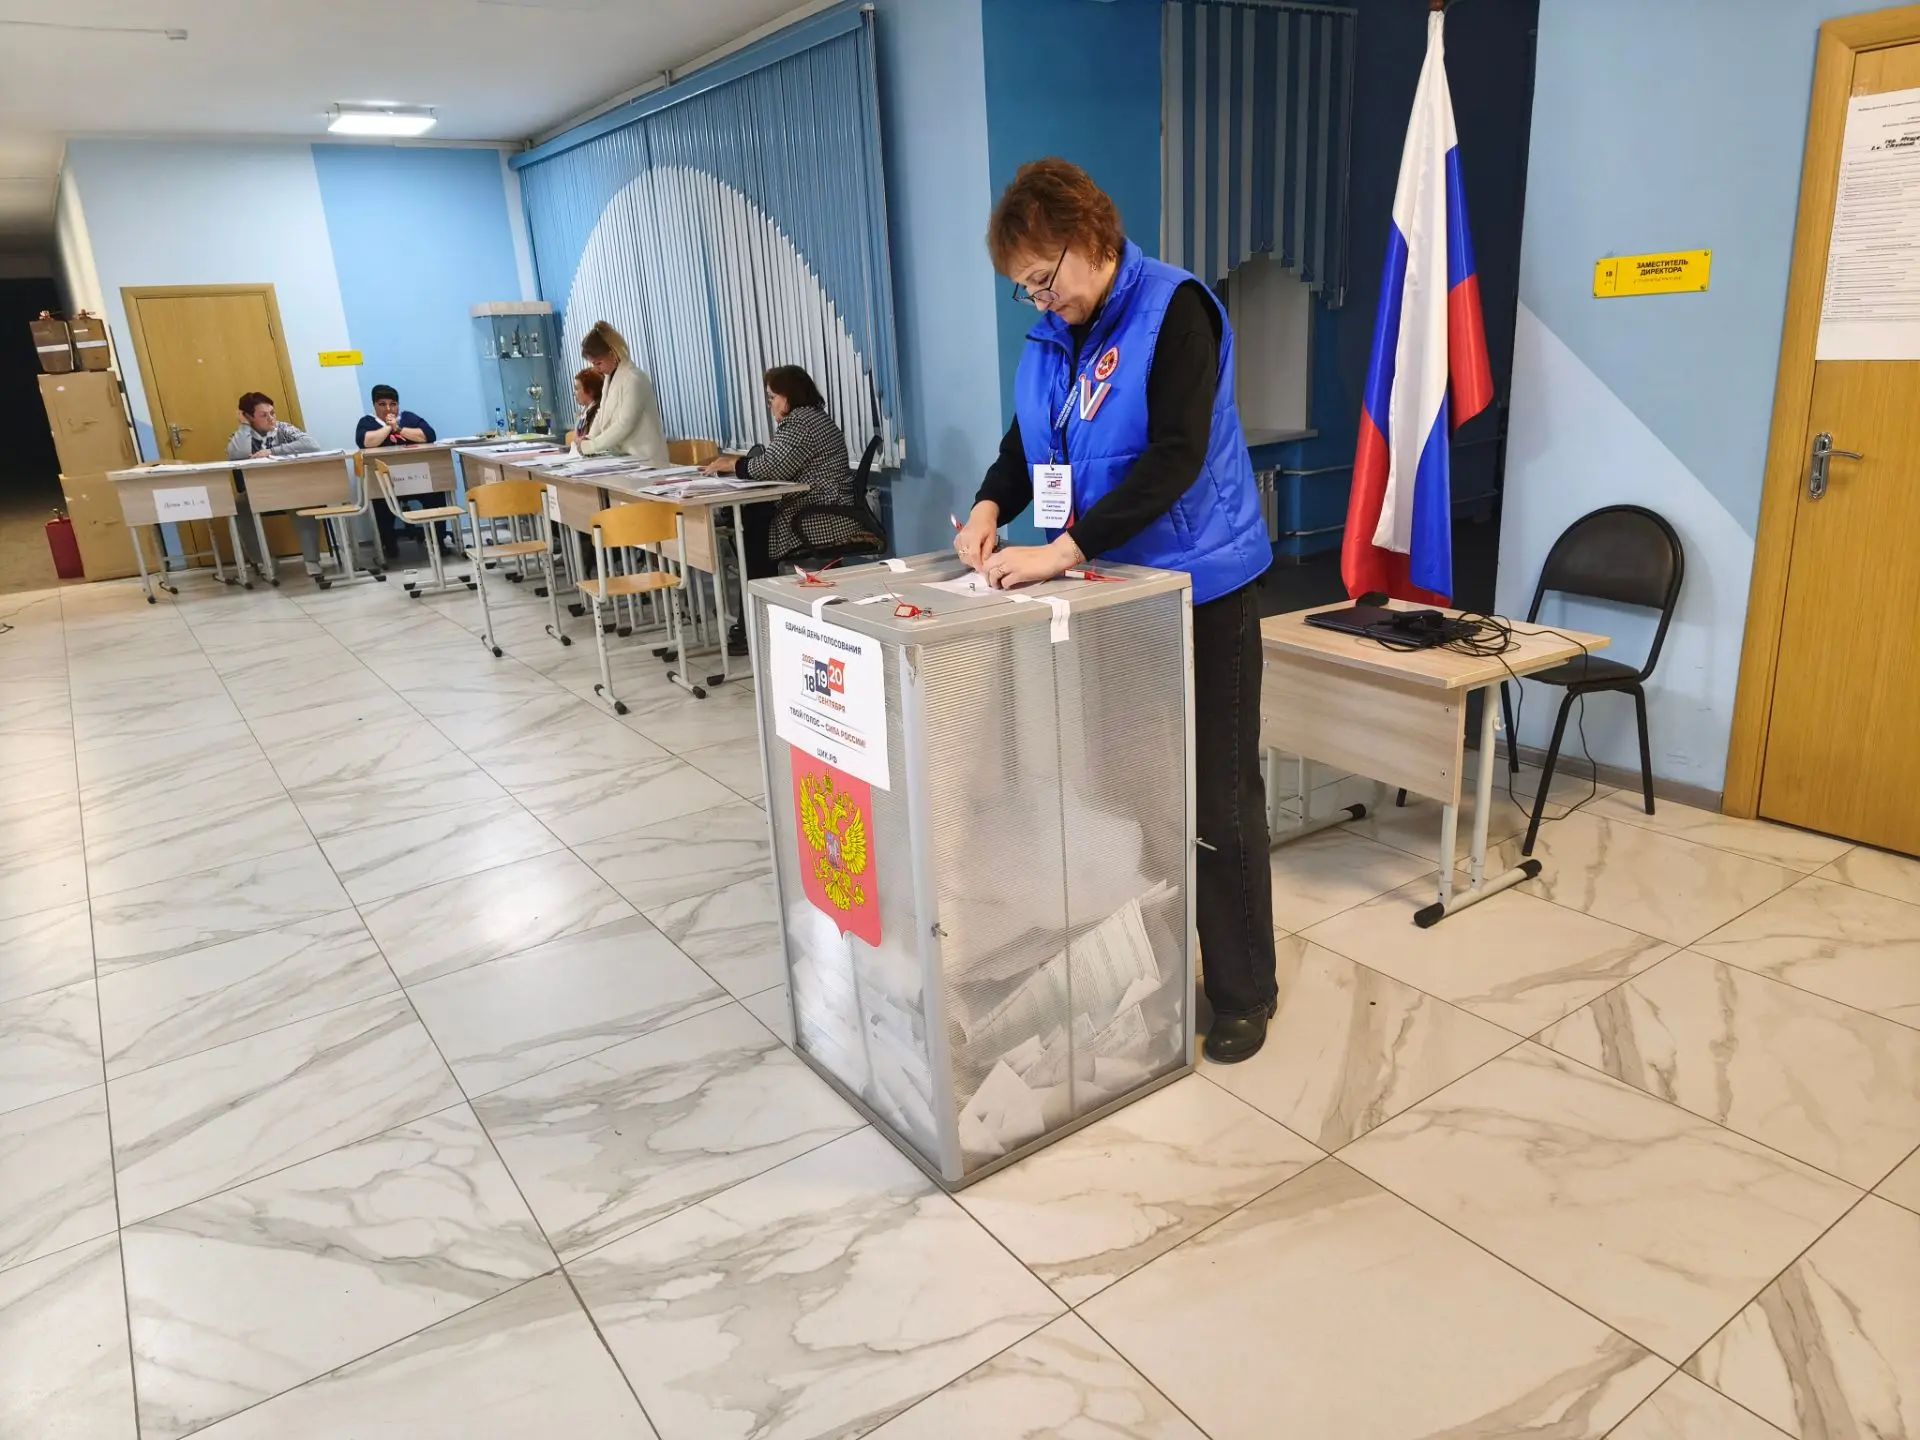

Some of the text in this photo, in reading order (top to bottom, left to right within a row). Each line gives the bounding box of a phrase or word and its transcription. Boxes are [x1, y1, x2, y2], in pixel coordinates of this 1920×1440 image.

[1637, 259, 1688, 269] ЗАМЕСТИТЕЛЬ
[1640, 266, 1682, 276] ДИРЕКТОРА
[785, 621, 861, 655] ЕДИНЫЙ ДЕНЬ ГОЛОСОВАНИЯ
[804, 666, 843, 692] 18 19 20
[818, 695, 846, 712] СЕНТЯБРЯ
[803, 712, 820, 727] ГОЛОС
[825, 723, 841, 736] СИЛА
